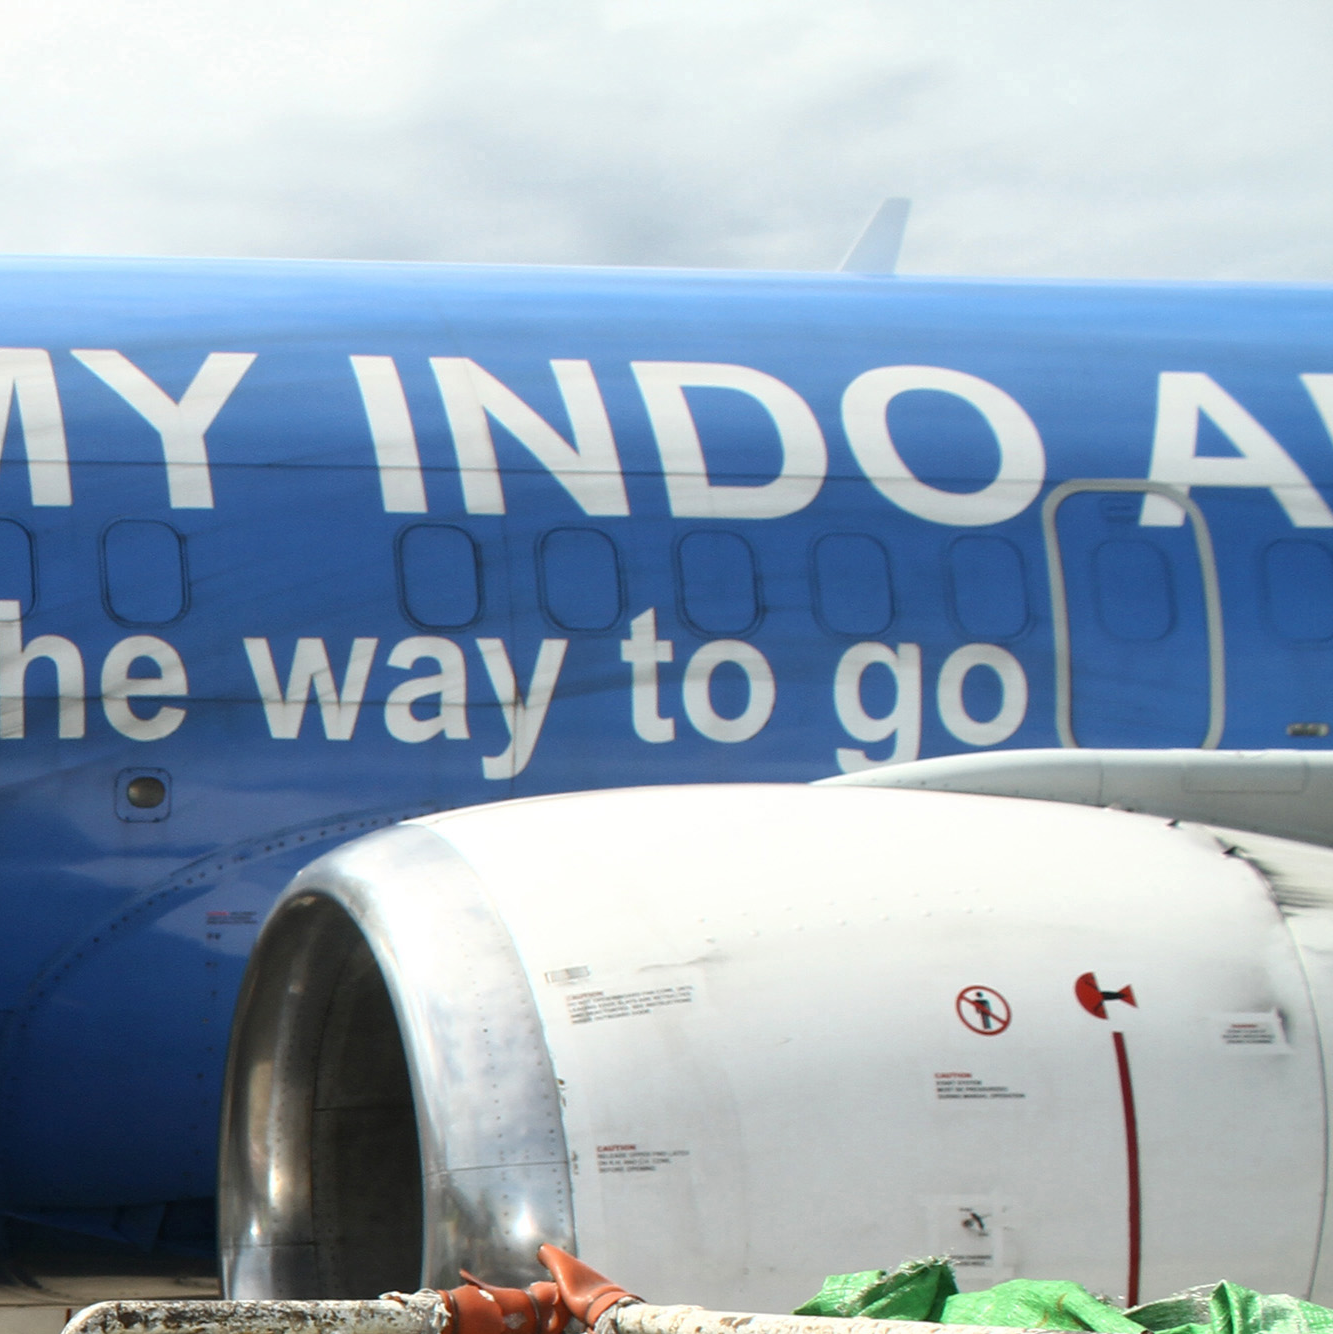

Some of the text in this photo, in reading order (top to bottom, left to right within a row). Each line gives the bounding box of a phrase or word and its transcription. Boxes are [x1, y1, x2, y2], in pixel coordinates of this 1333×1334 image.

[349, 353, 1046, 527] INDO
[243, 636, 569, 781] way
[621, 608, 776, 745] to
[833, 641, 1028, 774] go
